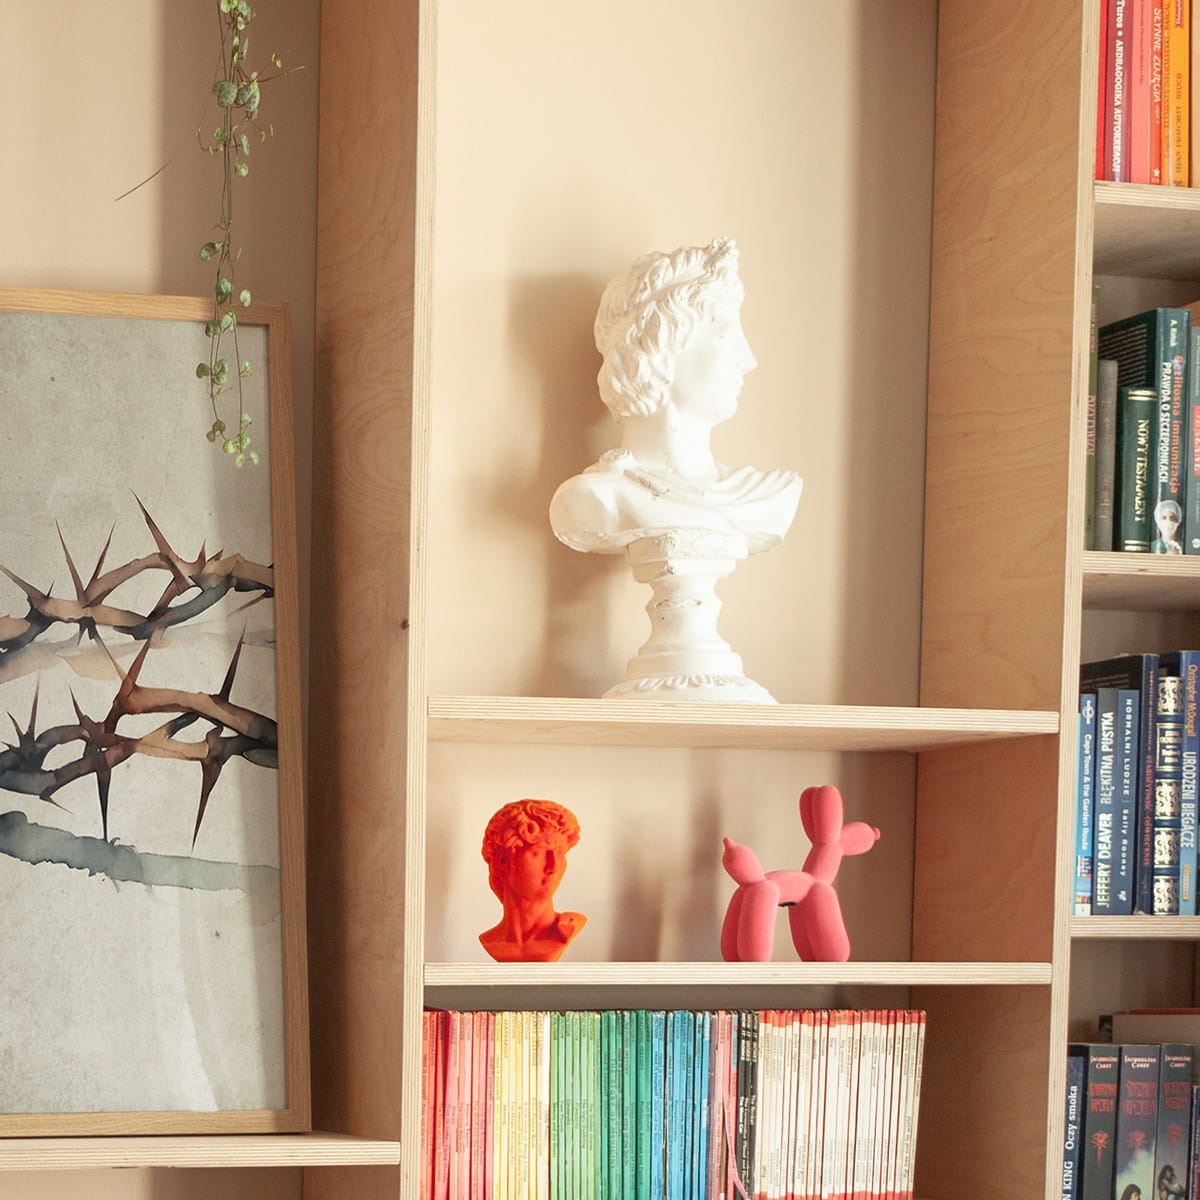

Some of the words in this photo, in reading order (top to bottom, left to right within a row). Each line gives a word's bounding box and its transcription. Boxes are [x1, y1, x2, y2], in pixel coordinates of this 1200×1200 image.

[1161, 361, 1172, 403] PRAWDA
[1172, 355, 1184, 416] Bezlitosna
[1161, 404, 1170, 412] O
[1137, 419, 1149, 450] NOWY
[1158, 412, 1172, 484] SZCZEPIONKACH
[1168, 421, 1183, 494] immunizacja
[1135, 451, 1148, 522] TESTAMENT
[1082, 734, 1092, 754] Cape
[1100, 712, 1115, 752] PUSTKA
[1124, 698, 1132, 754] NORMALNI
[1084, 755, 1092, 775] Town
[1122, 757, 1130, 796] LUDZIE
[1181, 751, 1196, 800] URODZENI
[1083, 784, 1091, 797] the
[1082, 798, 1090, 826] Garden
[1120, 808, 1128, 834] Sally
[1180, 803, 1195, 848] BIEGACZE
[1082, 828, 1090, 850] Route
[1097, 813, 1112, 859] DEAVER
[1119, 838, 1128, 877] Rooney
[1096, 862, 1111, 908] JEFFERY
[1068, 1086, 1078, 1121] smoka
[1064, 1123, 1077, 1150] Oczy
[1063, 1160, 1074, 1190] KING
